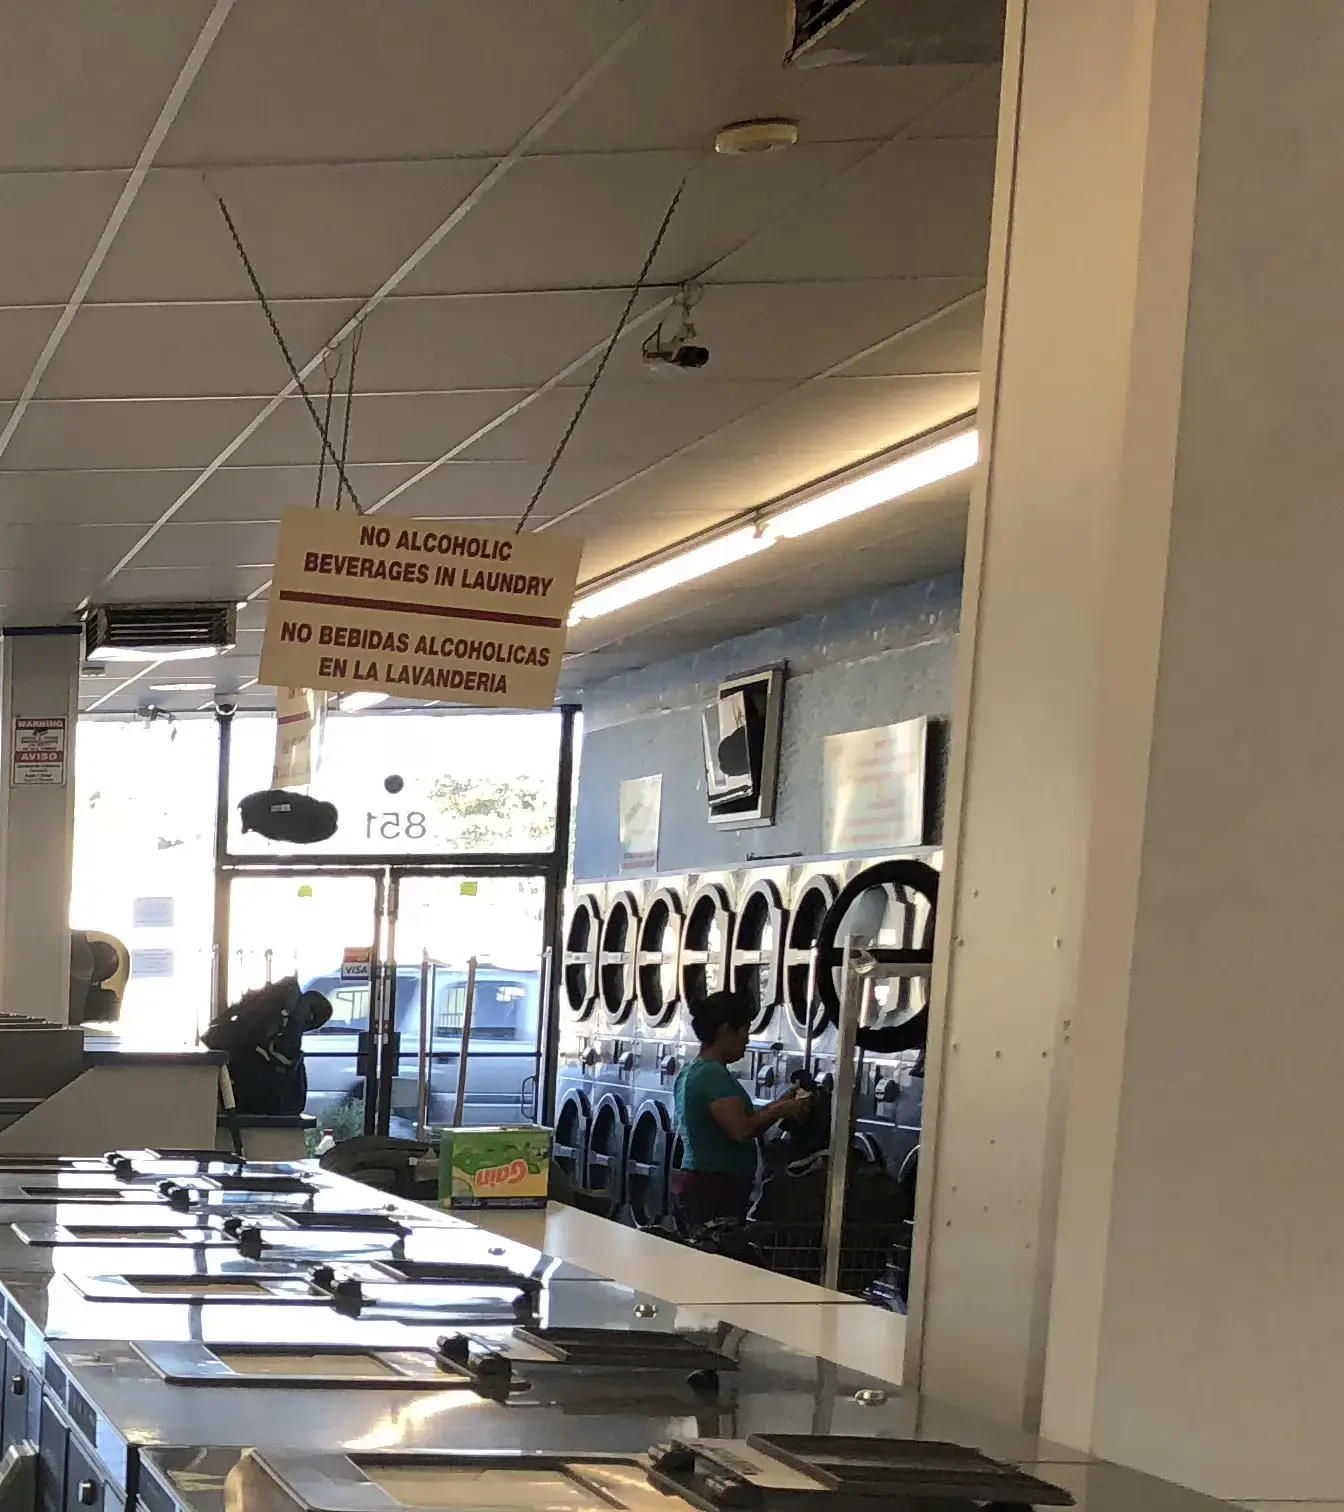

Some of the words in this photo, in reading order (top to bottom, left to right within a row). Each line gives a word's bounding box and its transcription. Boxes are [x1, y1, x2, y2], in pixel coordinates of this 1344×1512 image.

[359, 525, 391, 548] NO
[395, 530, 513, 562] ALCOHOLIC
[303, 552, 429, 584] BEVERAGES
[434, 565, 457, 588] IN
[461, 568, 554, 597] LAUNDRY
[280, 621, 312, 644] NO
[318, 624, 409, 654] BEBIDAS
[413, 634, 550, 668] ALCOHOLICAS
[318, 656, 348, 679] EN
[353, 659, 380, 682] LA
[385, 662, 508, 694] LAVANDERIA
[20, 752, 58, 761] AVISO
[345, 965, 368, 975] VISA
[476, 1159, 527, 1189] Gain
